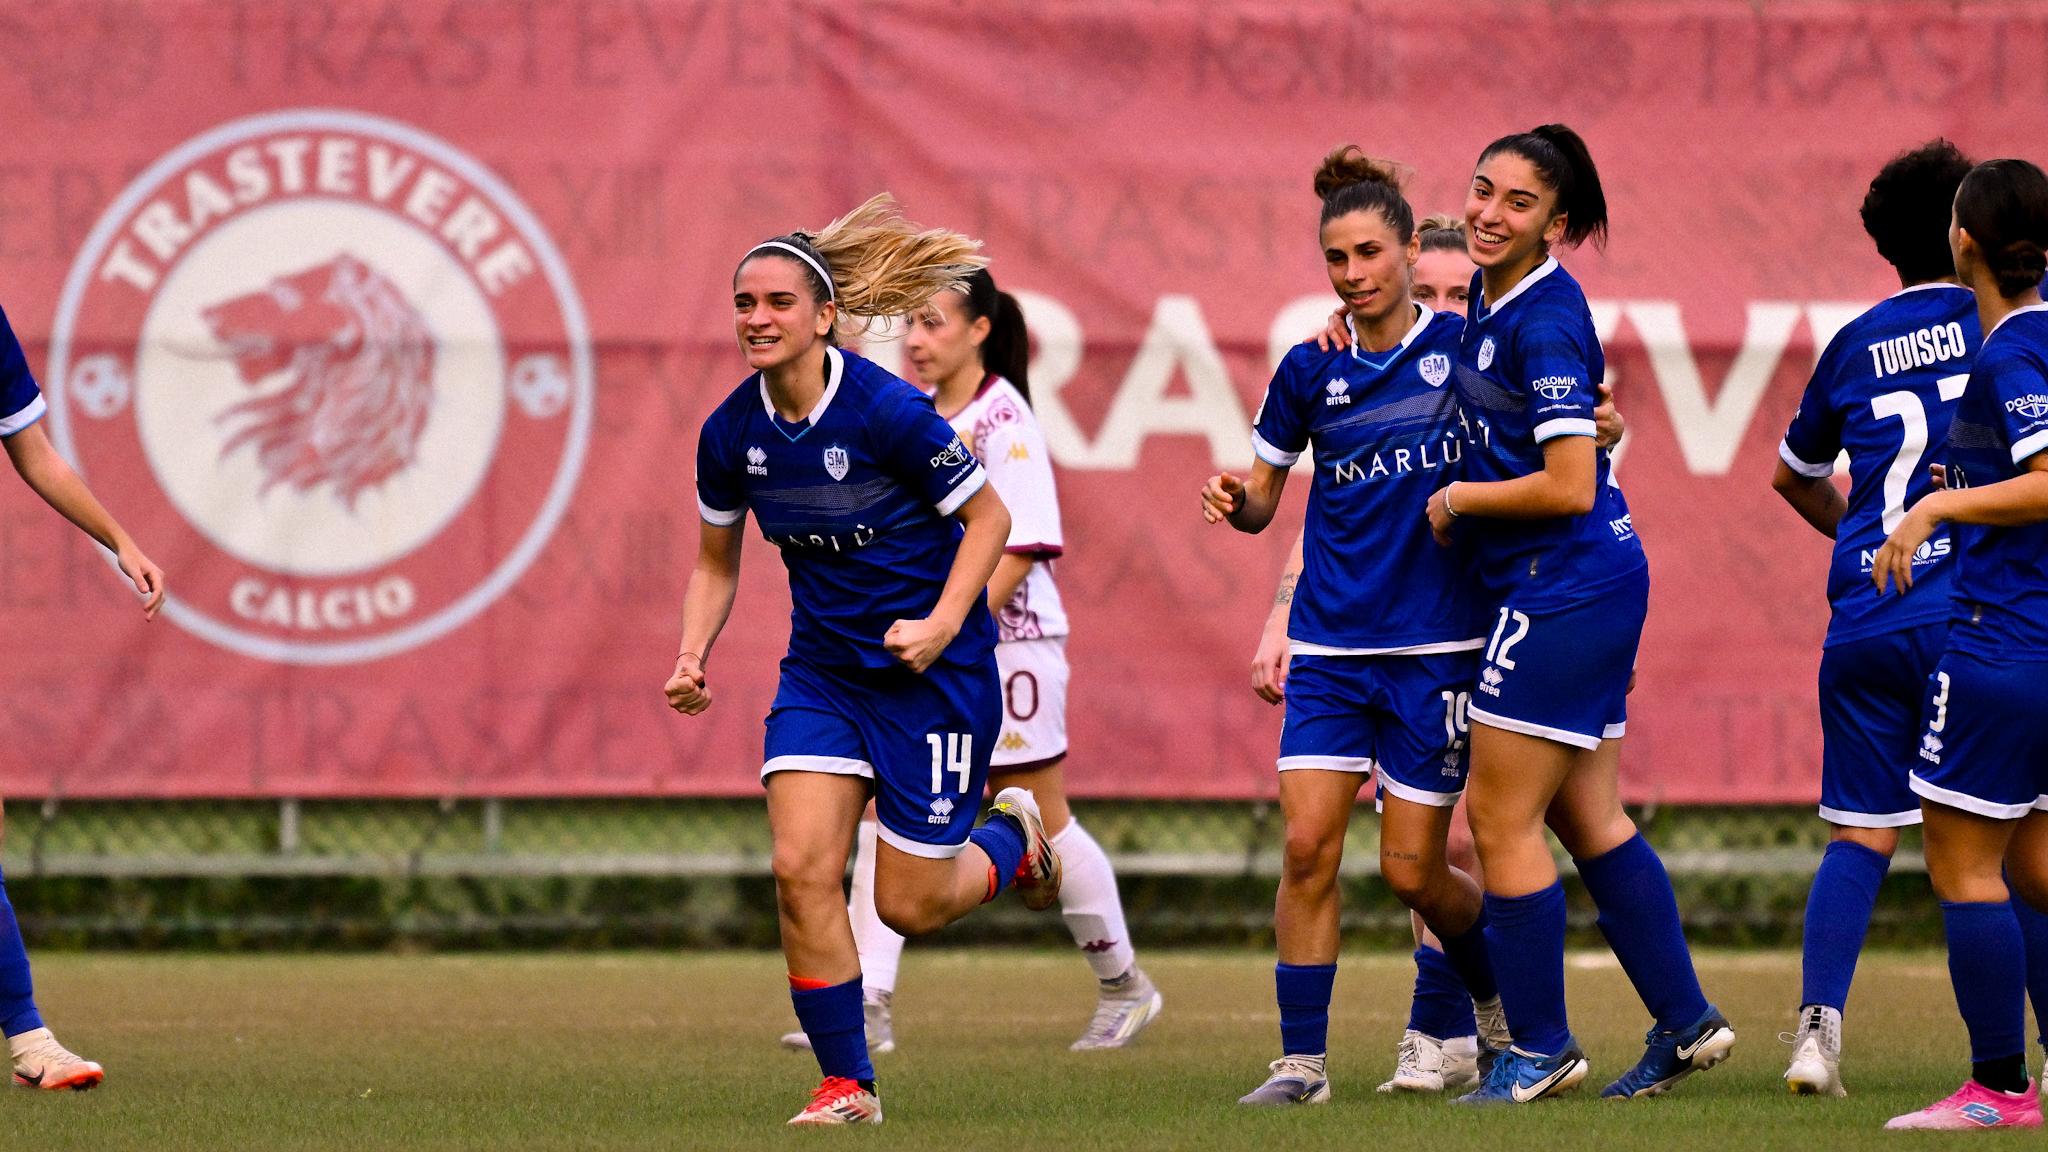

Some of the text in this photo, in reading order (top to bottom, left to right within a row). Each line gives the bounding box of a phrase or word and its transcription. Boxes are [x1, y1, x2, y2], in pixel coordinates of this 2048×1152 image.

[101, 136, 534, 294] TRASTEVERE
[1868, 321, 1966, 379] TUDISCO
[1532, 376, 1578, 391] DOLOMIA
[1335, 431, 1462, 485] MARLÙ
[229, 575, 416, 631] CALCIO
[1485, 606, 1530, 671] 12
[1929, 671, 1951, 733] 3
[926, 732, 973, 794] 14
